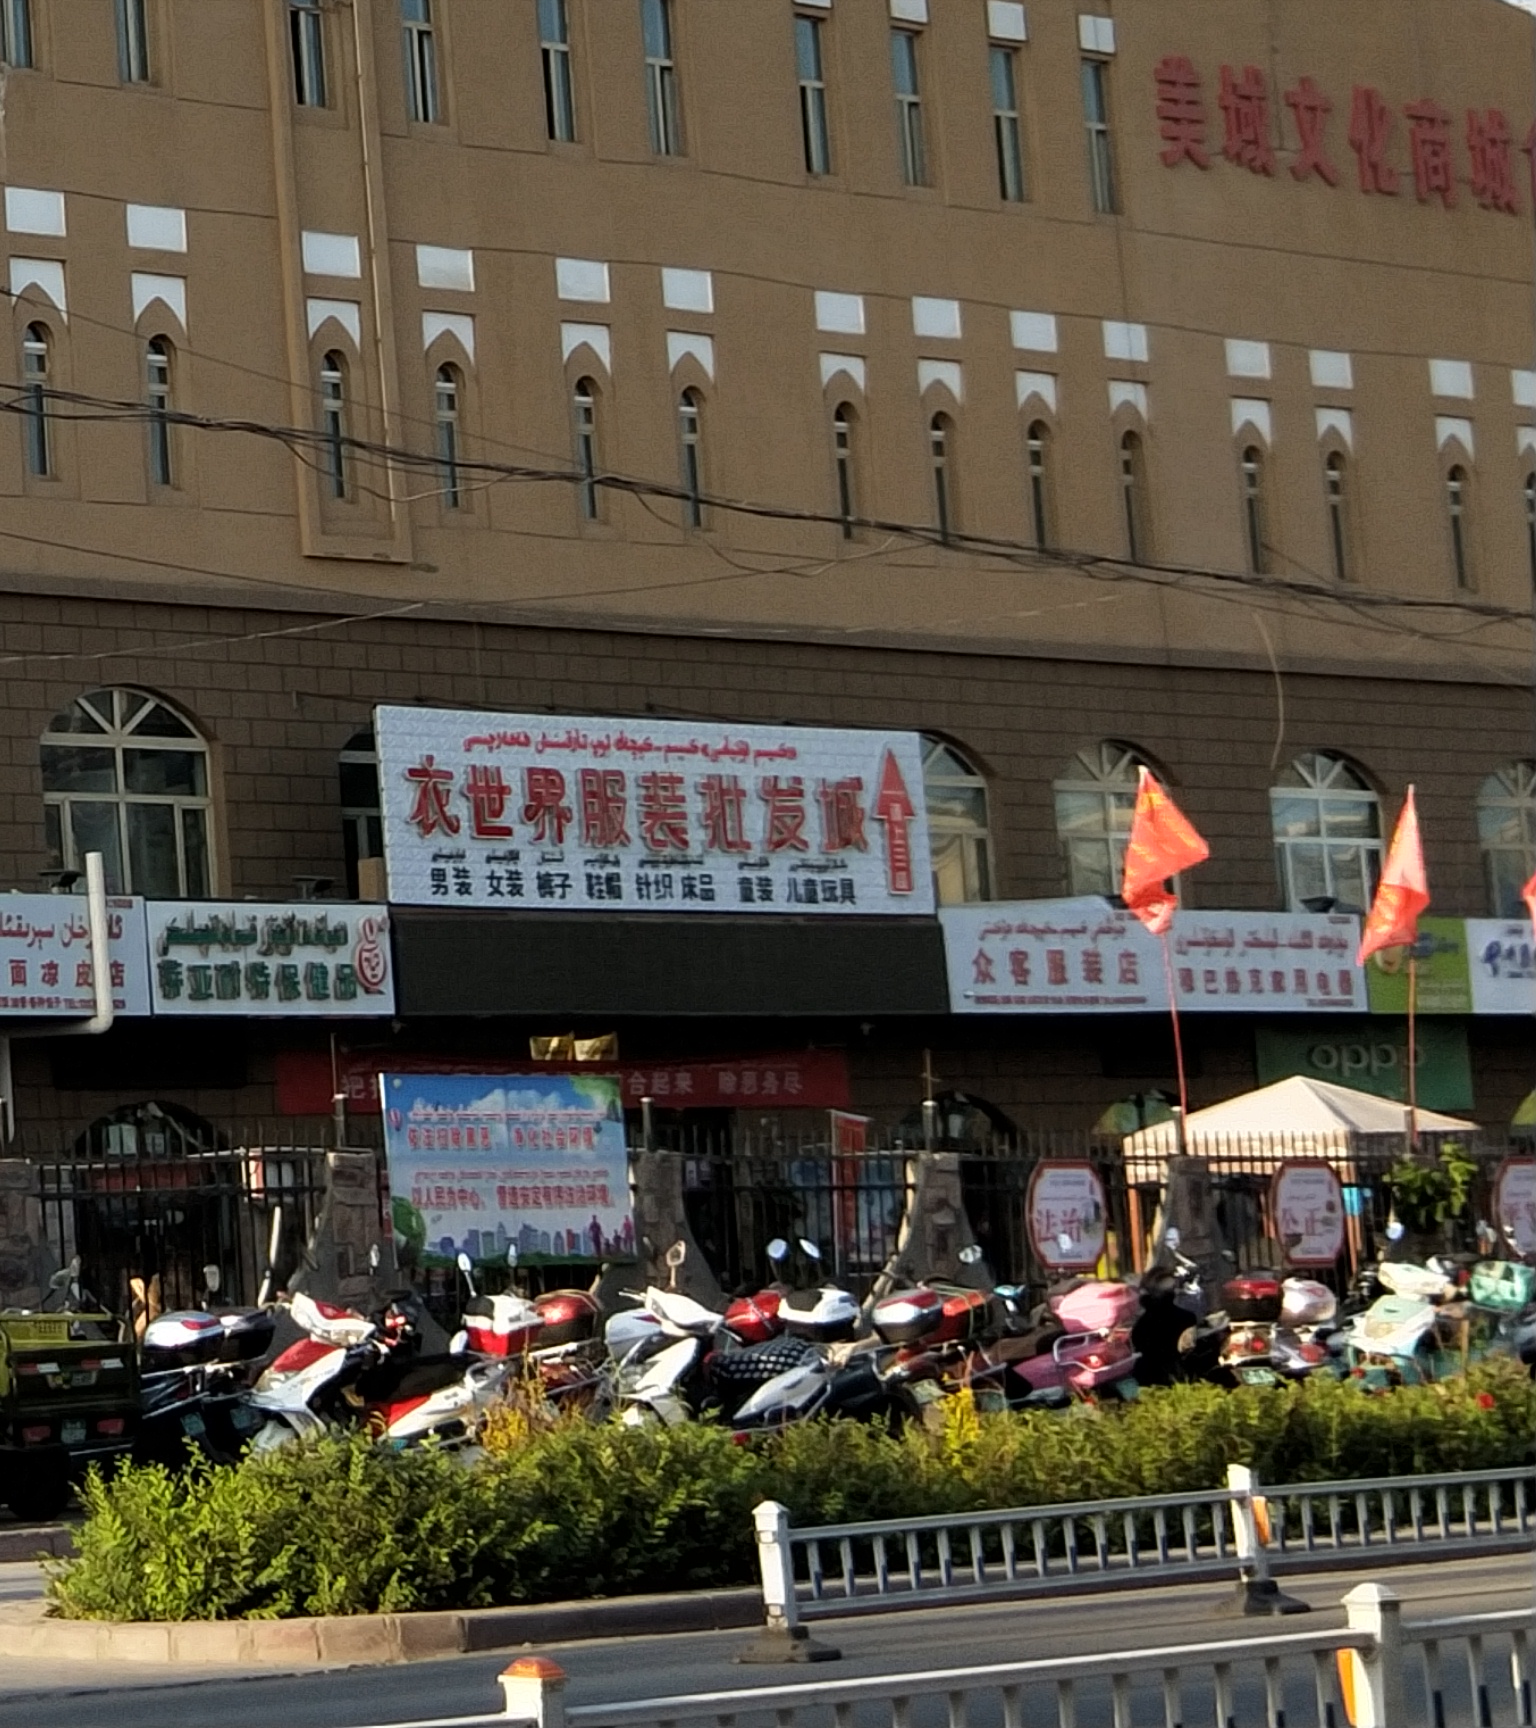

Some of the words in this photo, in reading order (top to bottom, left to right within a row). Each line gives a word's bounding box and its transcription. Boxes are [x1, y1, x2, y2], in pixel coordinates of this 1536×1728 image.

[405, 753, 870, 855] 衣世界服装批发城
[431, 867, 473, 897] 男装
[485, 868, 525, 898] 女装
[536, 871, 574, 900] 裤子
[737, 875, 774, 903] 童装
[786, 876, 857, 905] 儿童玩具
